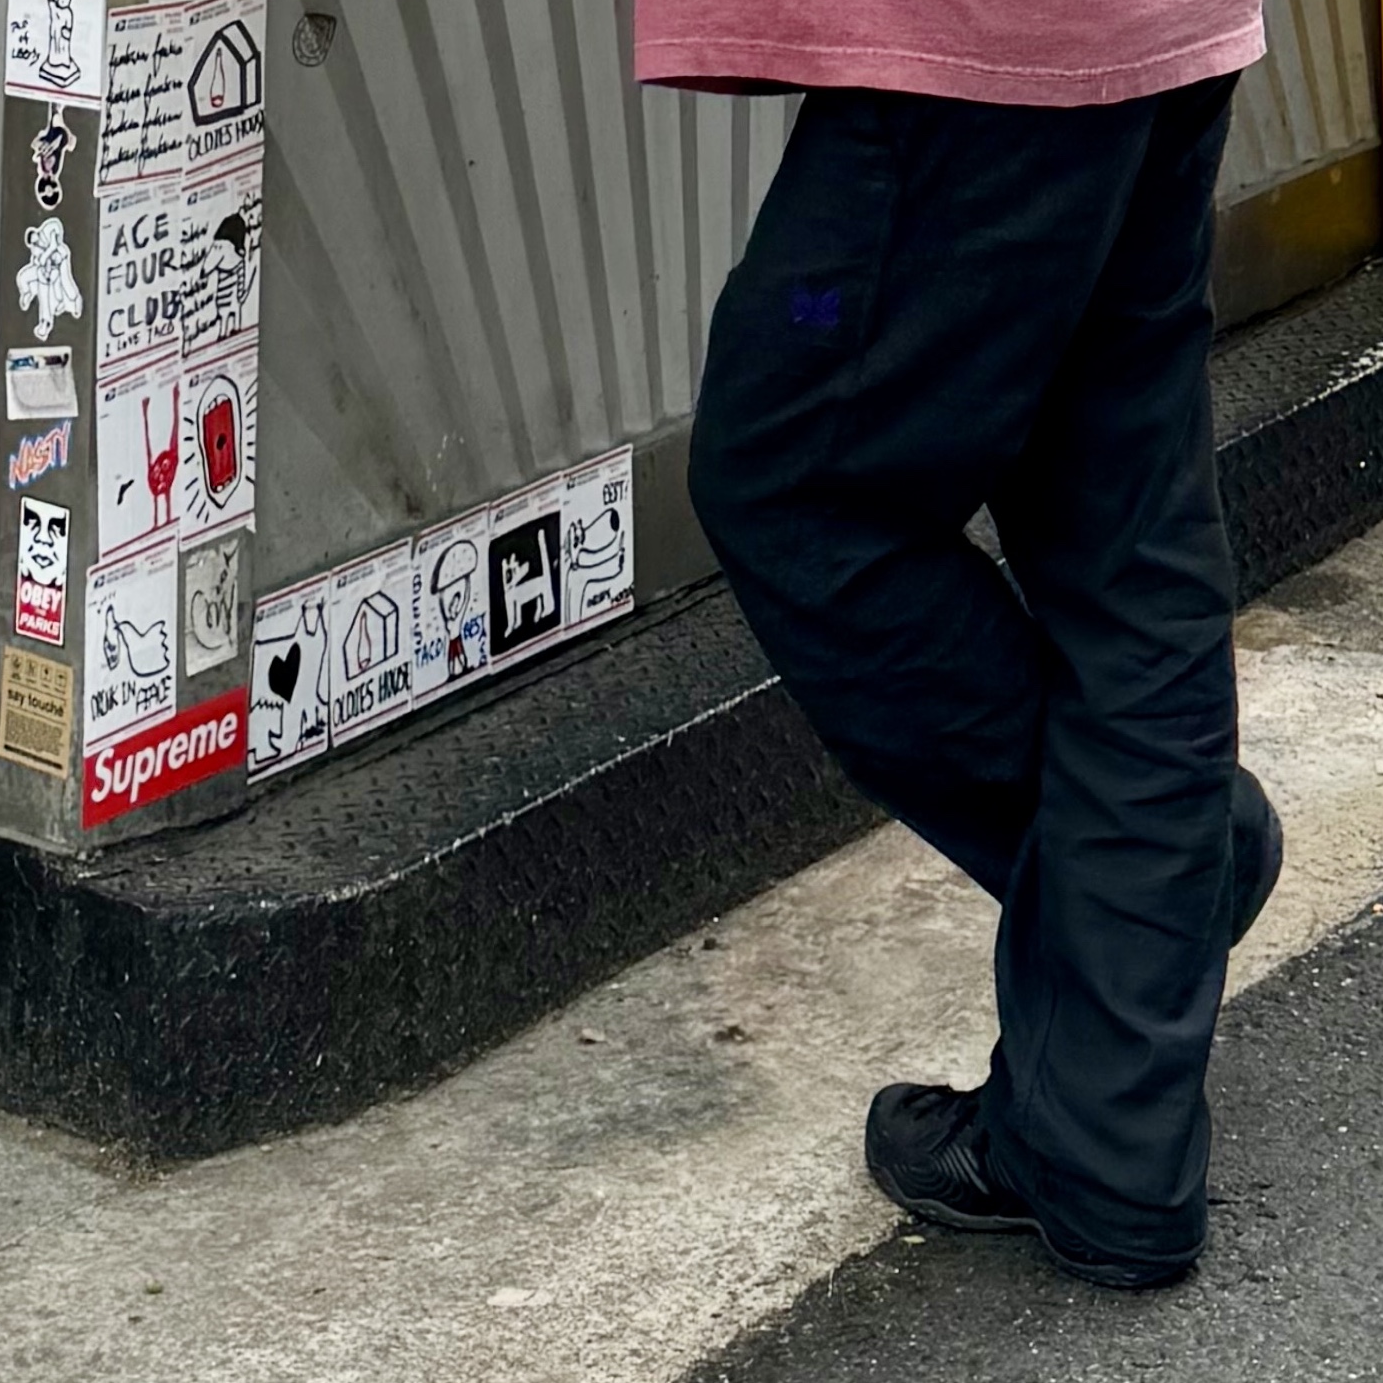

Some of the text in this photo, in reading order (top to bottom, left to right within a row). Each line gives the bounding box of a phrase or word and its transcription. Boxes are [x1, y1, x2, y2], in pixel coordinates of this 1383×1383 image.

[111, 212, 170, 257] ACE
[106, 248, 178, 296] FOUR
[107, 290, 181, 338] CLUB
[21, 583, 62, 613] OBEY
[7, 689, 29, 708] say
[91, 708, 239, 805] Supreme
